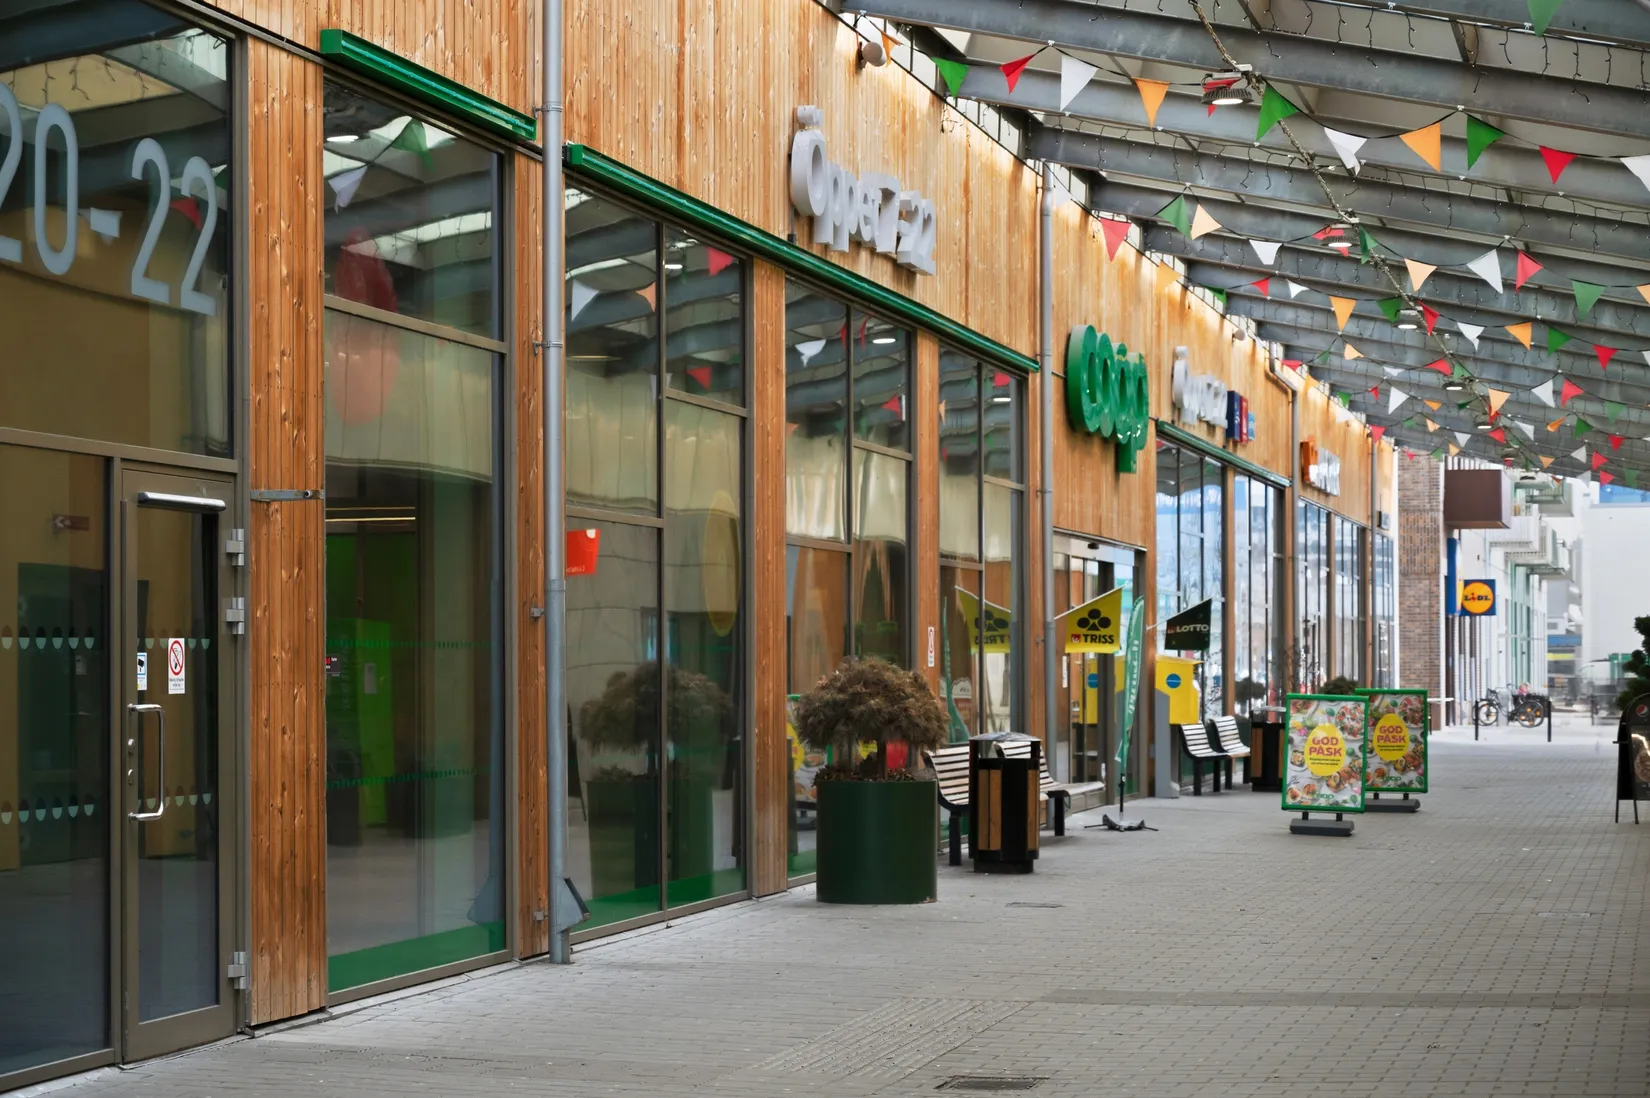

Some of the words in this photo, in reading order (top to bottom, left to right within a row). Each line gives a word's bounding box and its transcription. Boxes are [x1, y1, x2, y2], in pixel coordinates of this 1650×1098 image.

[1176, 624, 1210, 632] LOTTO
[1083, 634, 1115, 644] TRISS
[1379, 725, 1403, 734] GOD
[1312, 736, 1338, 745] GOD
[1377, 734, 1406, 744] PÅSK
[1309, 745, 1342, 756] PÅSK
